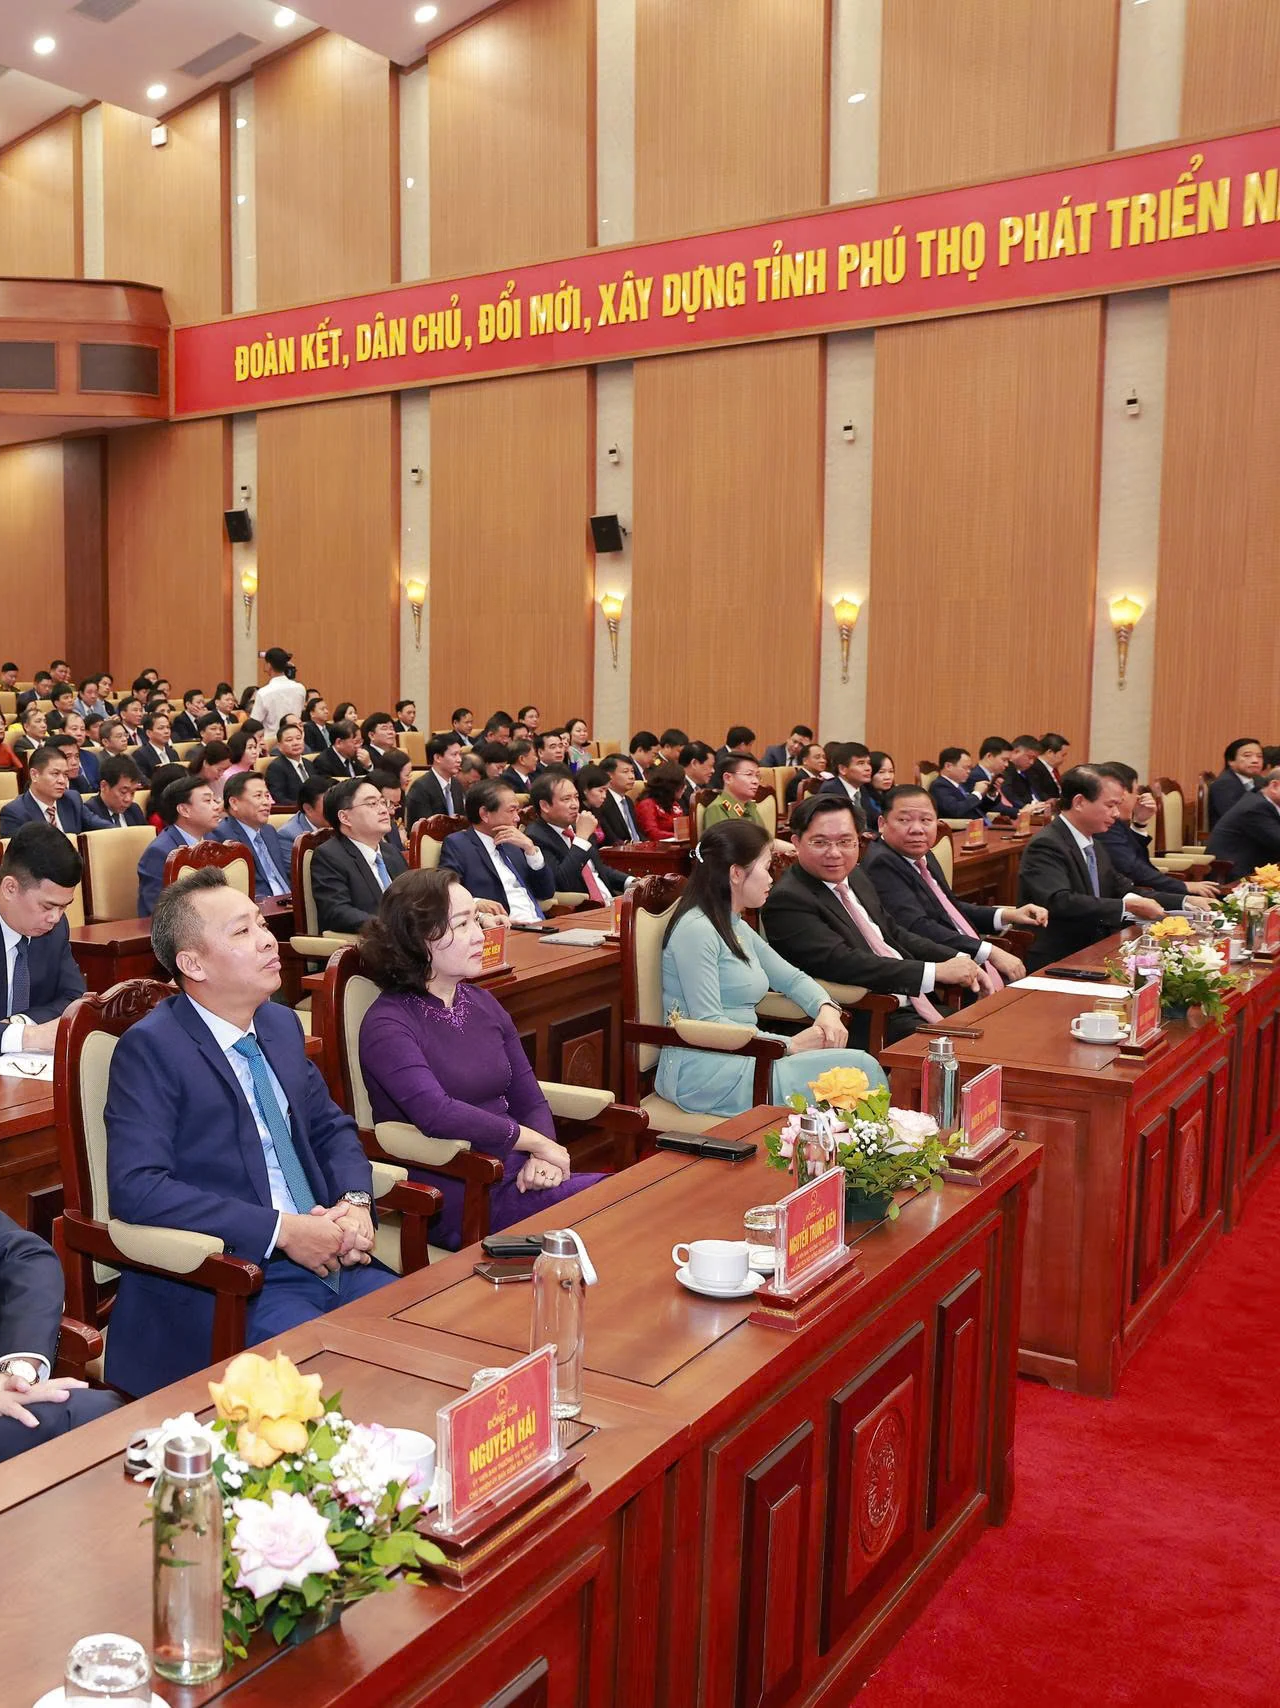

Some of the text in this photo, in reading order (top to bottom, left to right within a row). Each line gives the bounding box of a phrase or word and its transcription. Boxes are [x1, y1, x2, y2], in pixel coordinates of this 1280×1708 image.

[234, 332, 295, 382] ĐOÀN
[301, 316, 350, 371] KẾT,
[356, 311, 407, 362] DÂN
[412, 294, 472, 354] CHỦ,
[478, 279, 522, 344] ĐỔI
[529, 277, 592, 336] MỚI,
[598, 270, 654, 326] XÂY
[662, 261, 746, 323] DỰNG
[753, 239, 827, 302] TỈNH
[837, 224, 907, 291] PHÚ
[916, 221, 986, 282] THỌ
[998, 195, 1098, 267] PHÁT
[1106, 153, 1231, 250] TRIỂN
[469, 1405, 536, 1475] NGUYỄN HẢI
